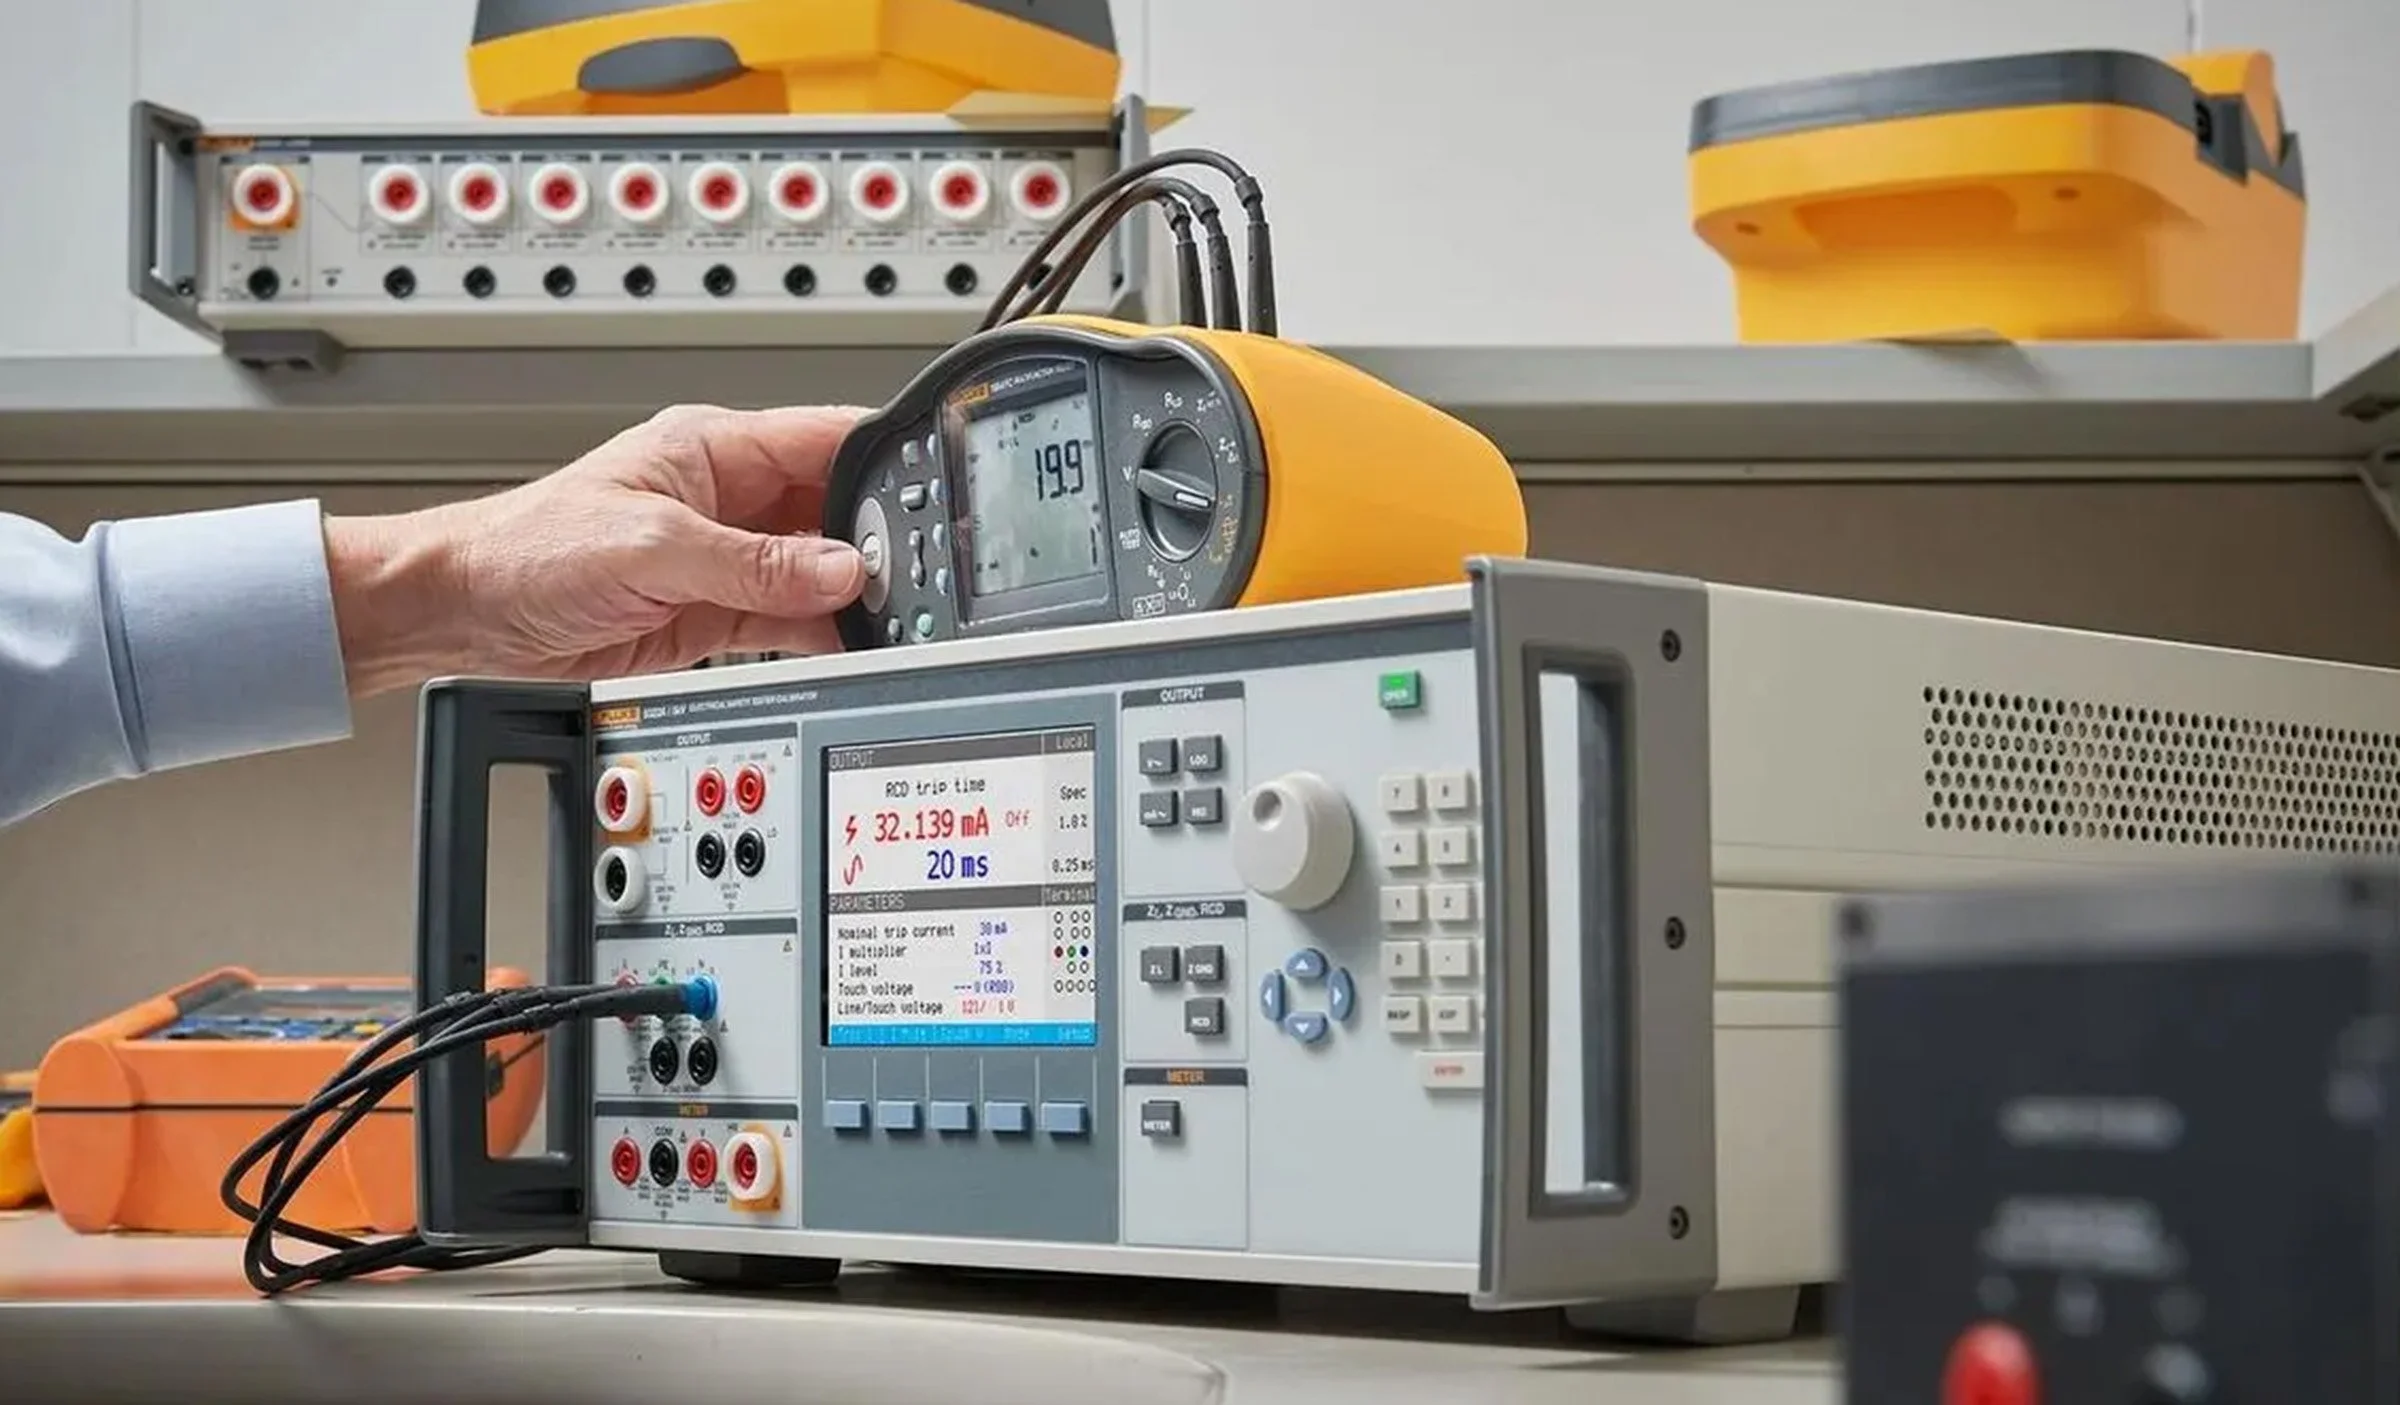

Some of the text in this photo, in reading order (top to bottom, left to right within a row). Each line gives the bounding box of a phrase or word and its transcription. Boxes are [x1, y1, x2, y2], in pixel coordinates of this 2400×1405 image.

[1035, 439, 1084, 502] 19.9
[1122, 467, 1132, 481] V
[1160, 687, 1204, 702] OUTPUT
[677, 733, 711, 747] OUTPUT
[1056, 732, 1088, 749] Local
[830, 750, 874, 769] OUTPUT
[886, 777, 985, 798] RCD trip time
[1060, 785, 1086, 802] Spec
[875, 808, 989, 842] 32.139 mA
[1006, 810, 1031, 827] Off
[927, 850, 989, 880] 20 ms
[829, 893, 905, 912] PARAMETERS
[1200, 903, 1225, 916] RCD
[838, 923, 955, 940] Nominal trip current
[849, 944, 908, 960] multiplier
[849, 963, 878, 977] level
[980, 960, 993, 974] 75
[838, 982, 914, 998] Touch voltage
[838, 1001, 943, 1016] Line/Touch voltage
[1167, 1070, 1204, 1084] METER
[1143, 1120, 1171, 1131] METER
